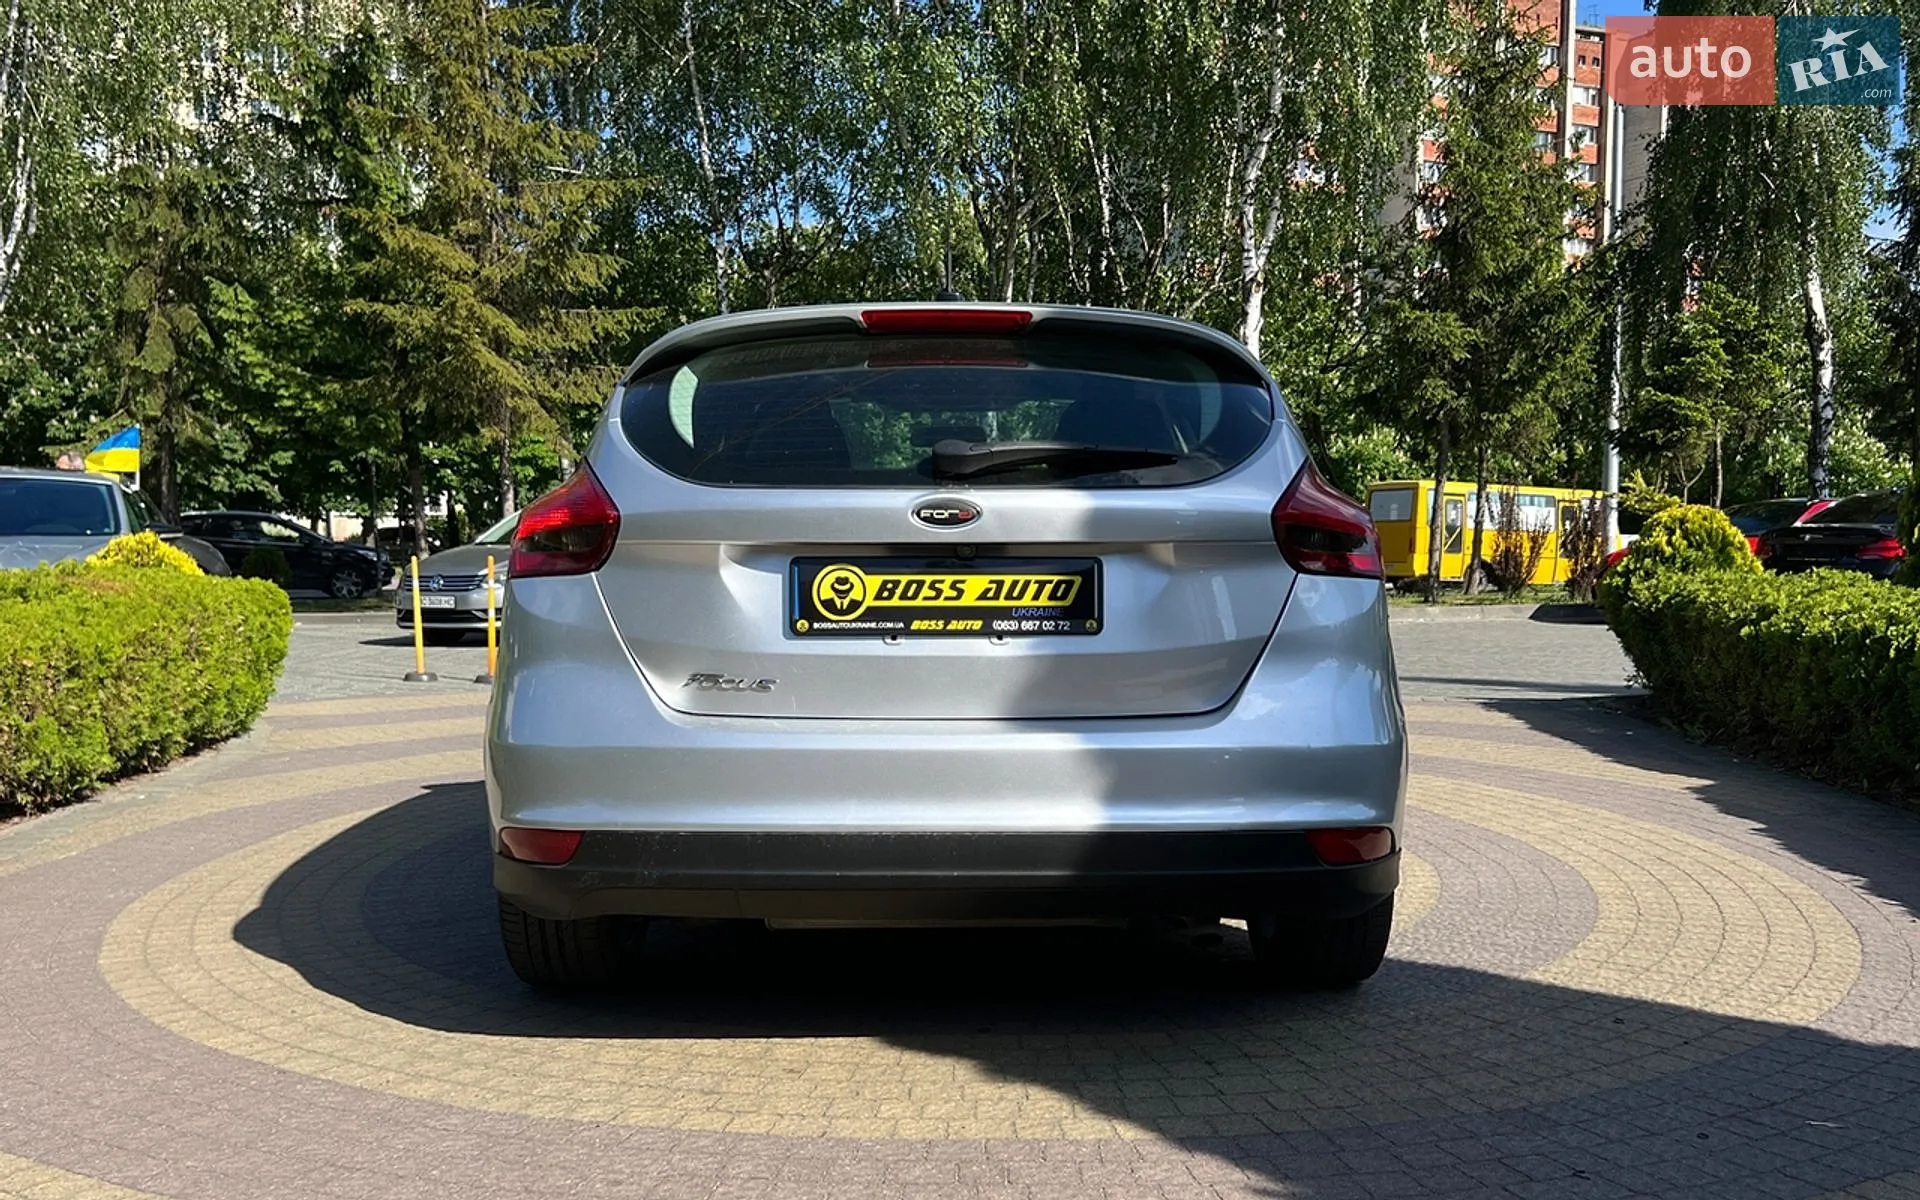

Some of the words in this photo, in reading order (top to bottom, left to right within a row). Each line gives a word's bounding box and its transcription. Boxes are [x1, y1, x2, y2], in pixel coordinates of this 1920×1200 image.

[873, 579, 966, 601] BOSS
[975, 579, 1077, 601] AUTO
[1012, 607, 1065, 617] UKRAINE
[910, 619, 945, 630] BOSS
[946, 620, 984, 630] AUTO
[1042, 620, 1056, 631] 02
[1057, 620, 1071, 631] 72
